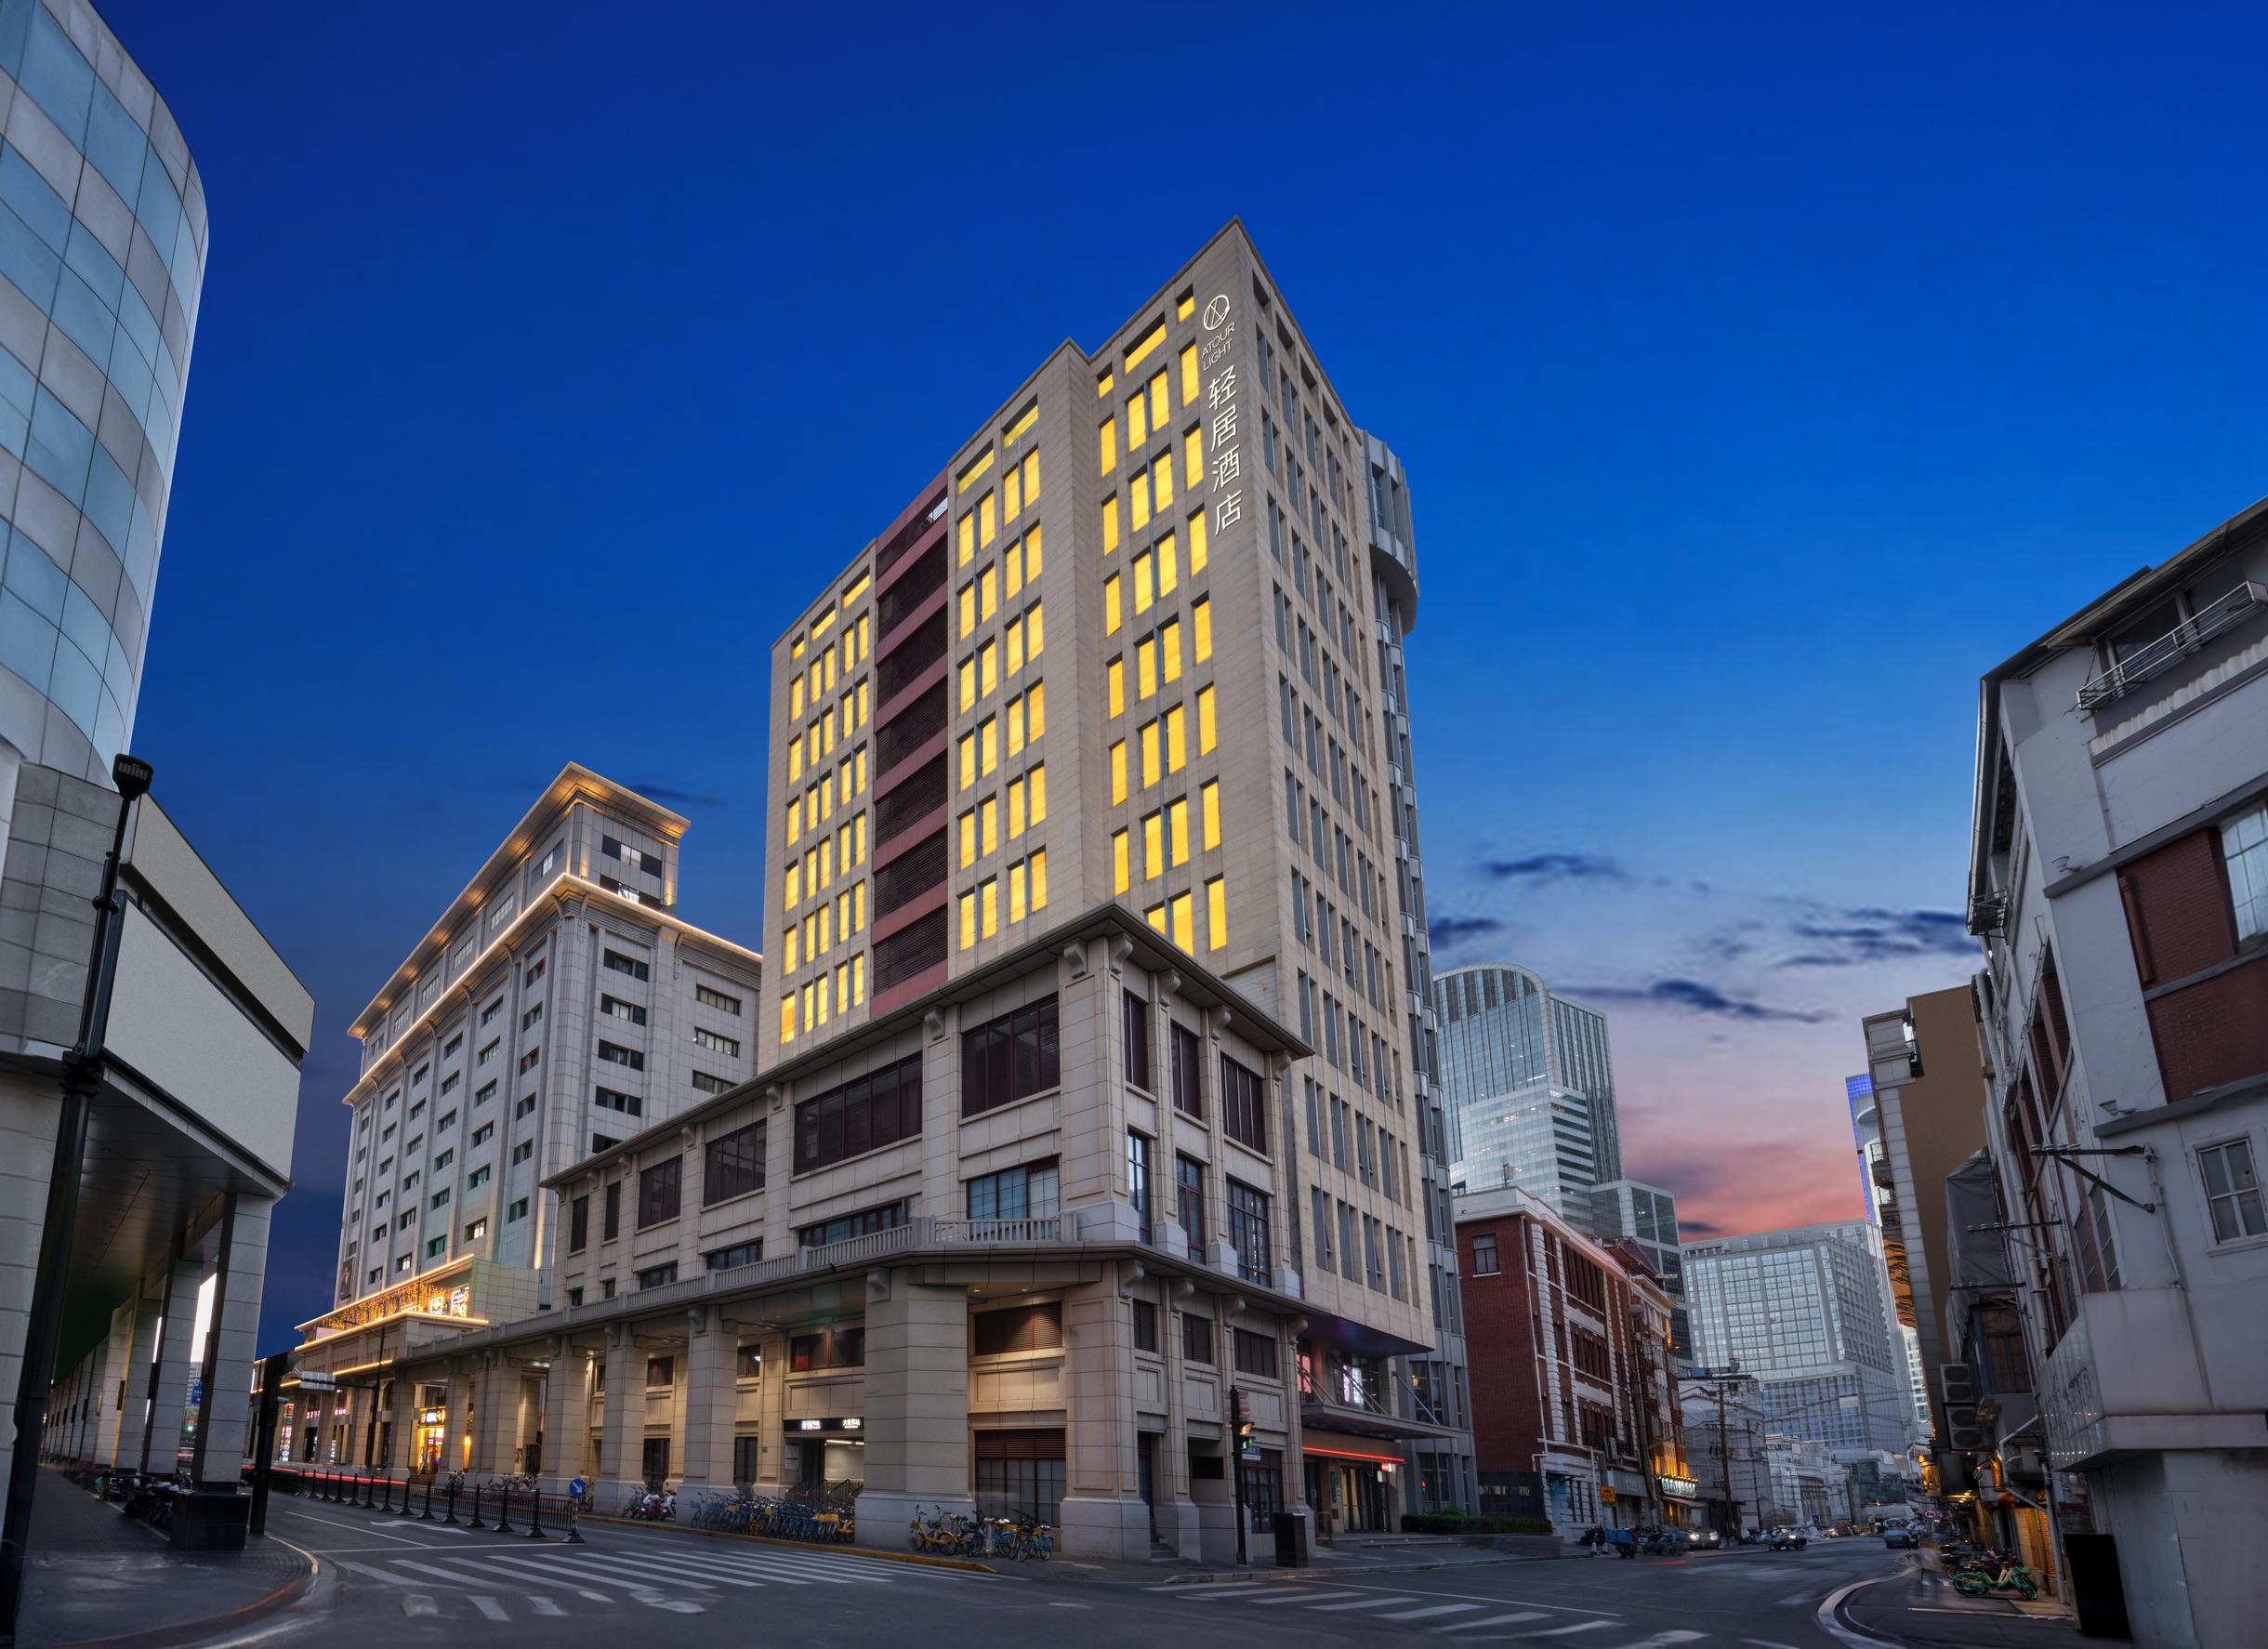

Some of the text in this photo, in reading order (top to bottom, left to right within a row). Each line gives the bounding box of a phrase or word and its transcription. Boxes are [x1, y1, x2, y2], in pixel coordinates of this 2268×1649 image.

[1201, 322, 1235, 359] ATOUR
[1203, 337, 1233, 372] LIGHT
[1208, 363, 1243, 536] 轻居酒店
